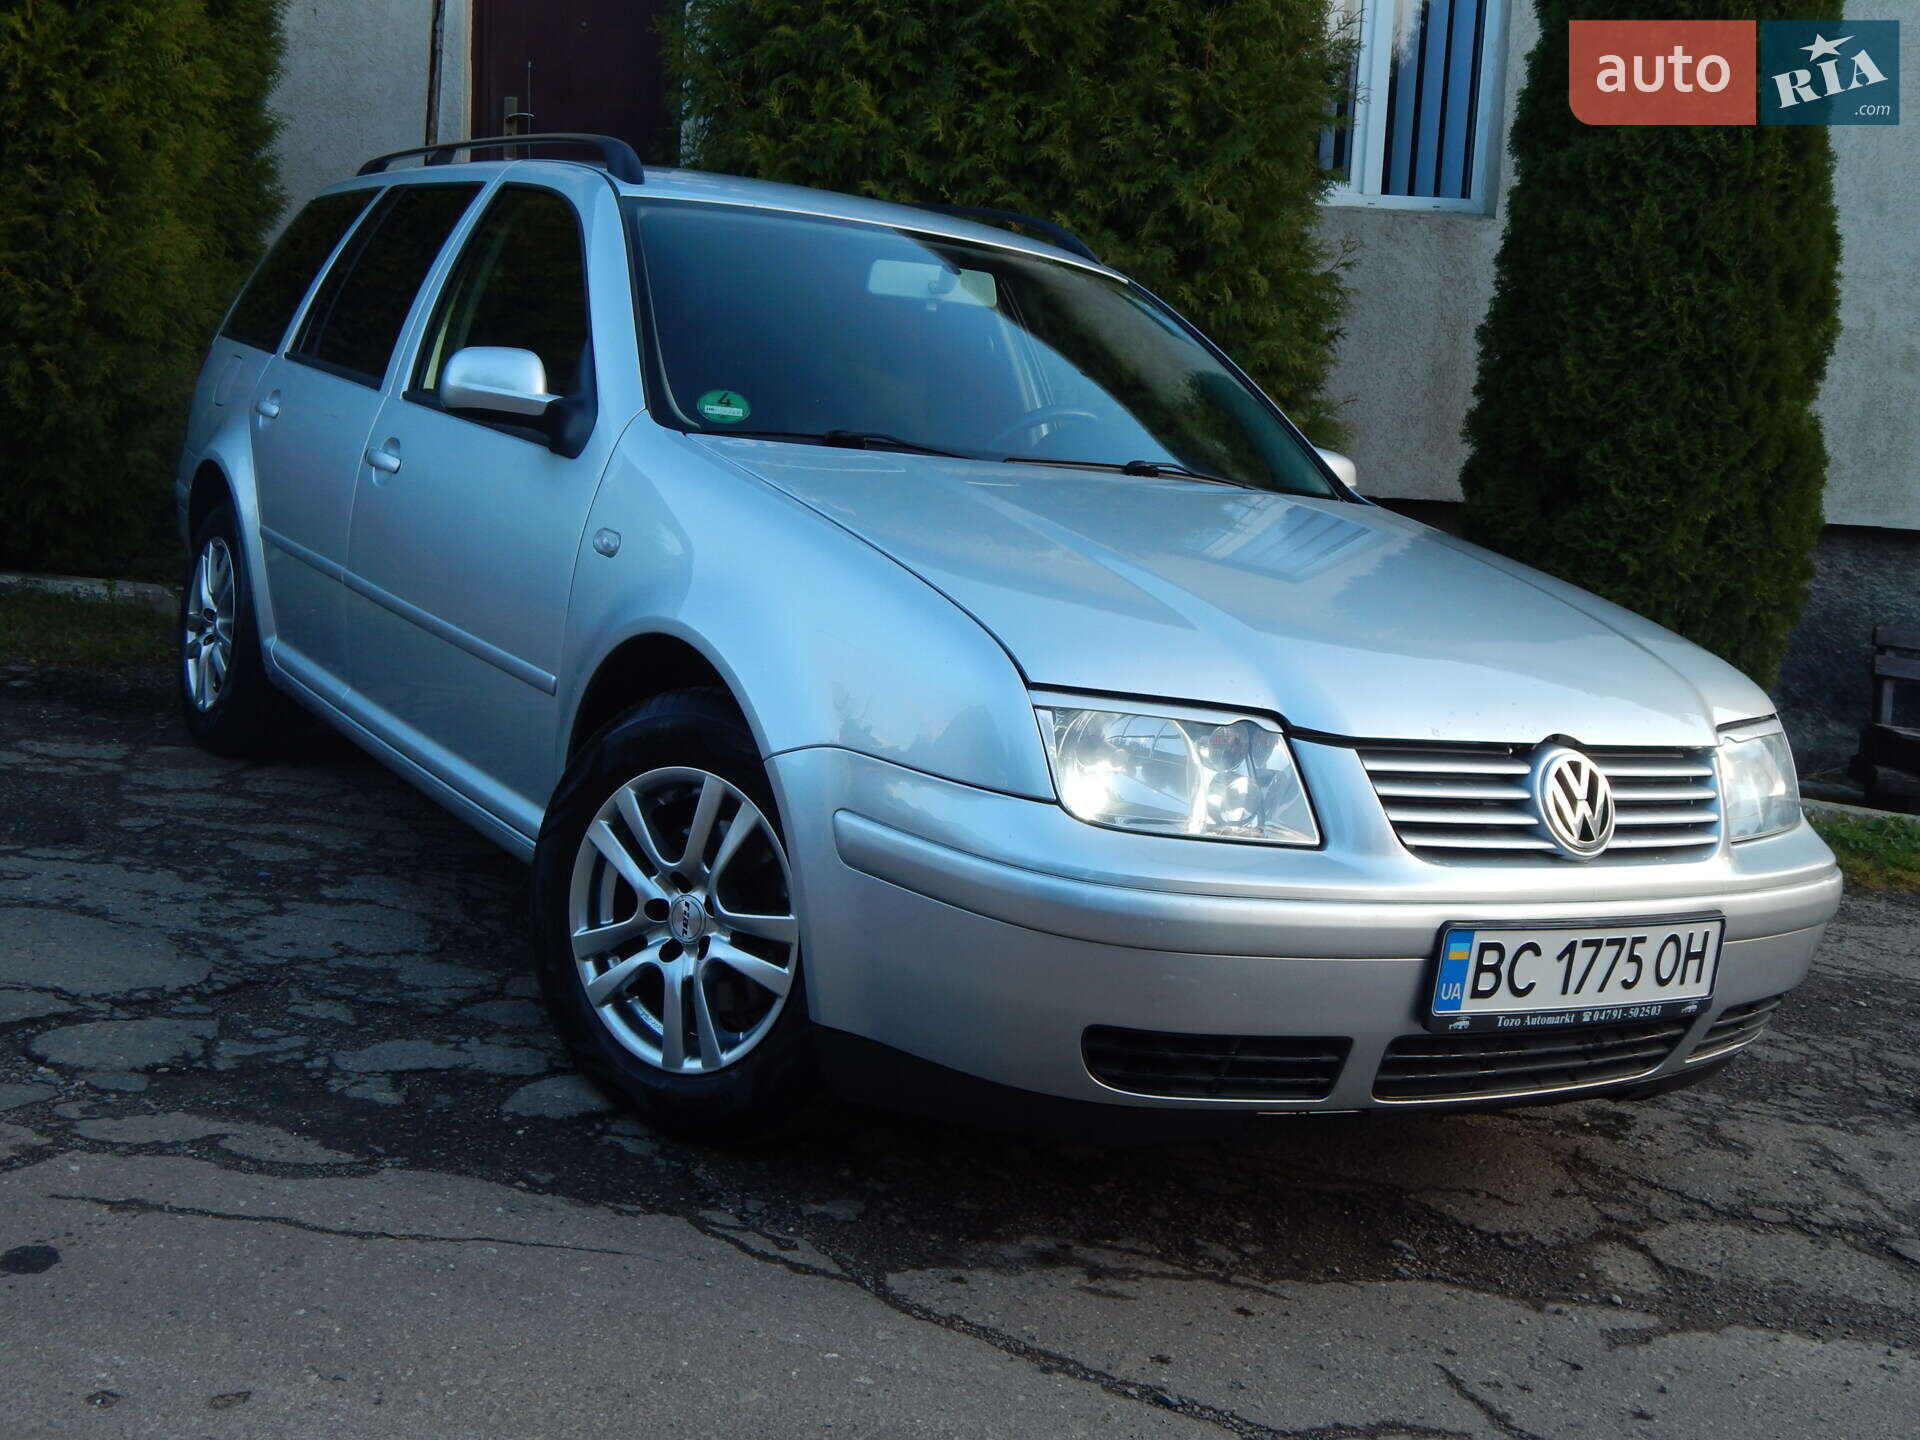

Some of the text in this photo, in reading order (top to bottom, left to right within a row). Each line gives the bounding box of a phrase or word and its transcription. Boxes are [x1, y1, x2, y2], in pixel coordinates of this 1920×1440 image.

[717, 392, 731, 407] 4
[1470, 930, 1710, 999] BC 1775 OH
[1441, 982, 1461, 1000] UA
[1523, 1013, 1575, 1026] Automarkt
